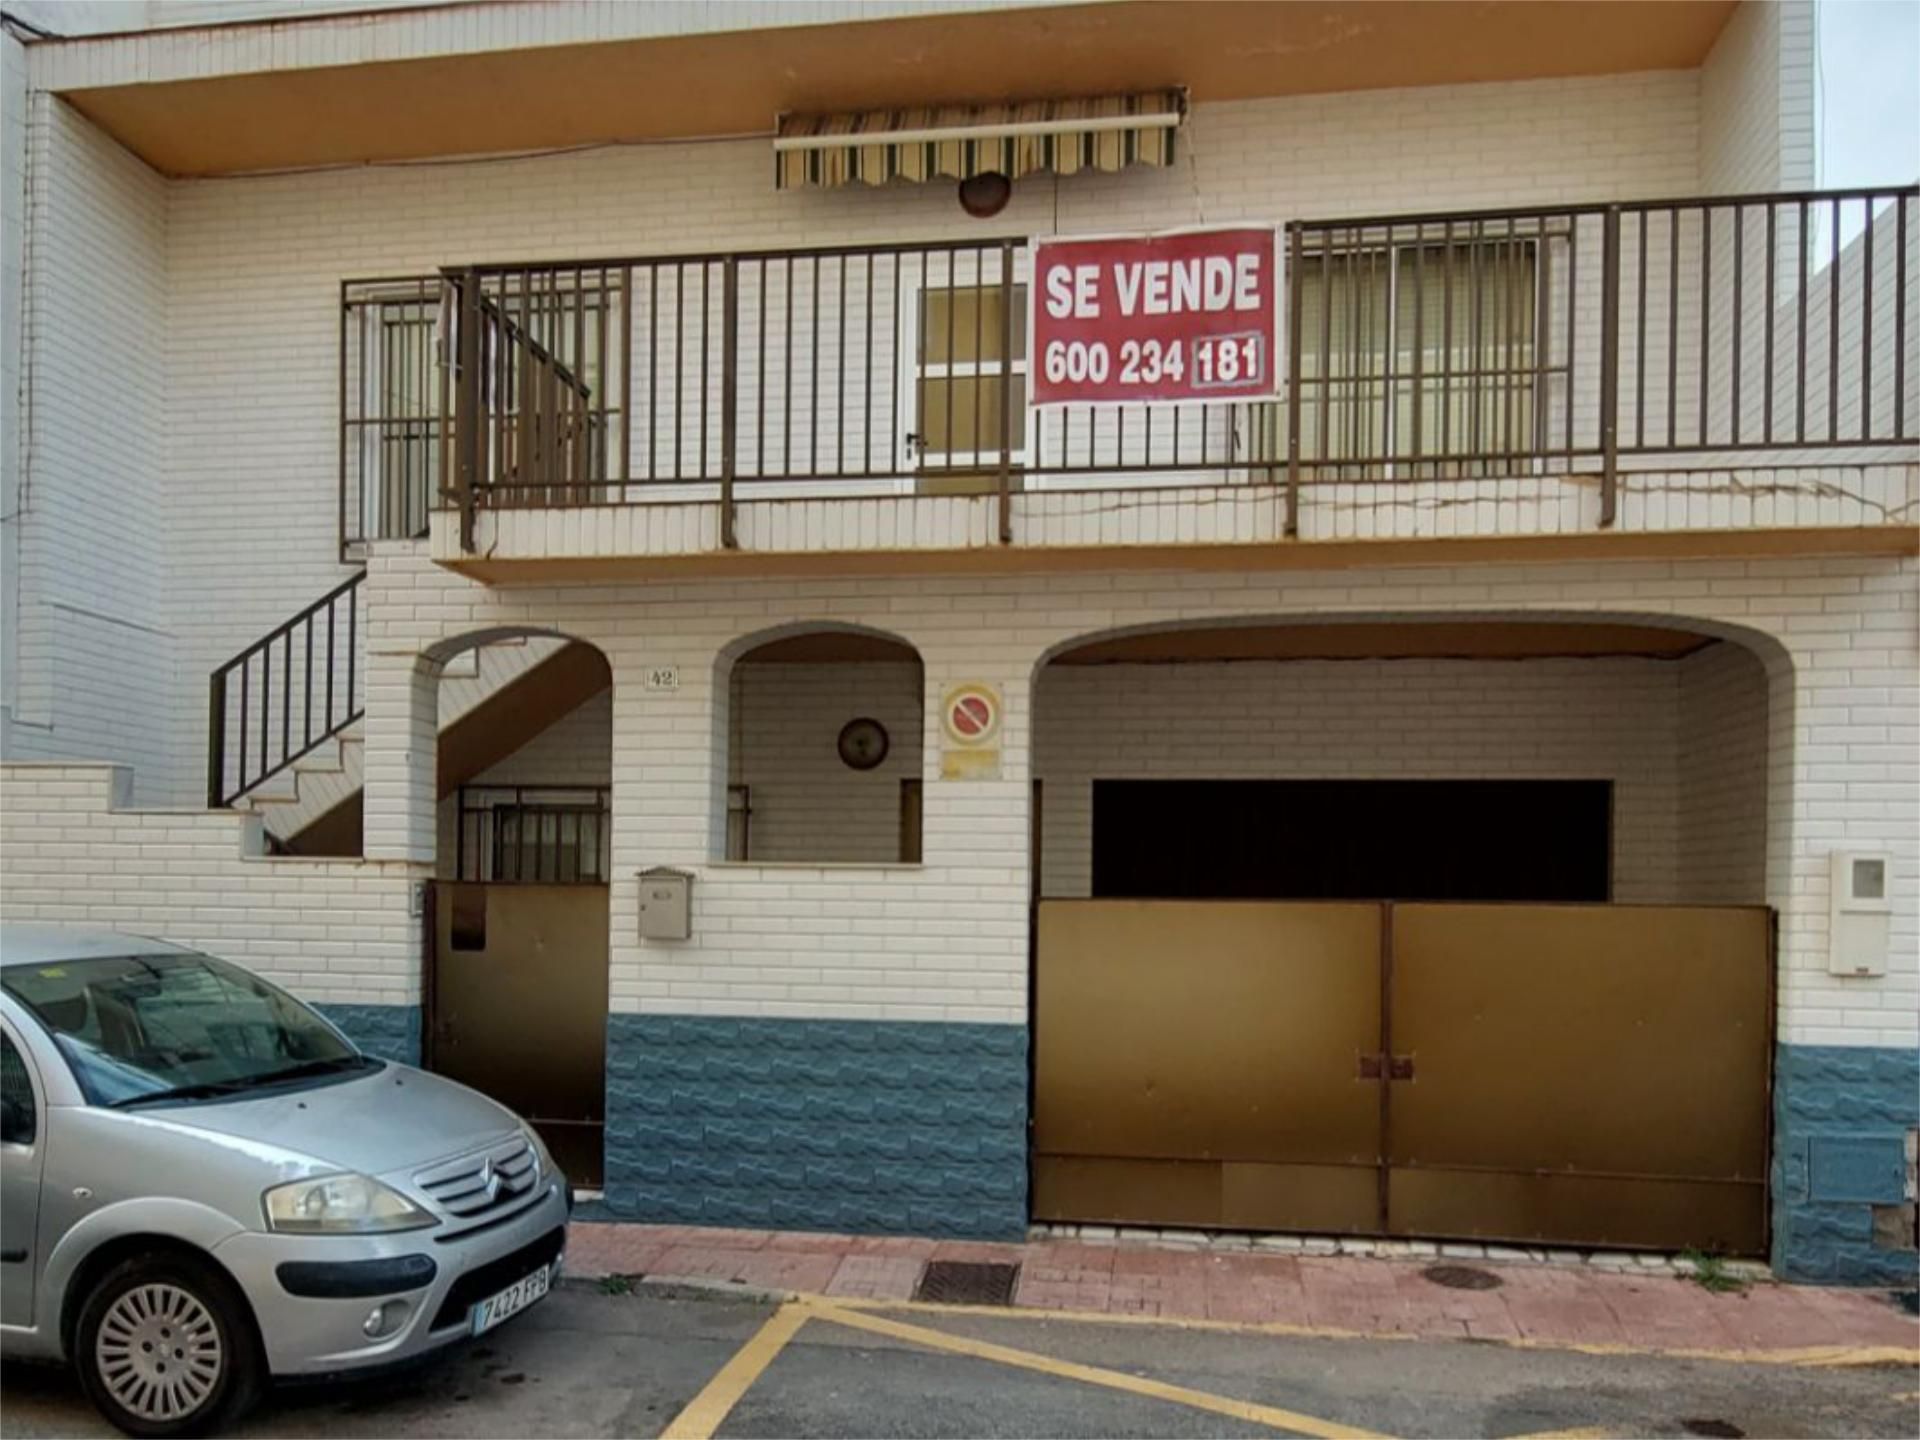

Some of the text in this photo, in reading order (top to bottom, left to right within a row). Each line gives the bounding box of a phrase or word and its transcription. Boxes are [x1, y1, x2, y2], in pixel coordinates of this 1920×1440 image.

[1046, 253, 1261, 319] SE VENDE
[1045, 338, 1258, 384] 600 234 181
